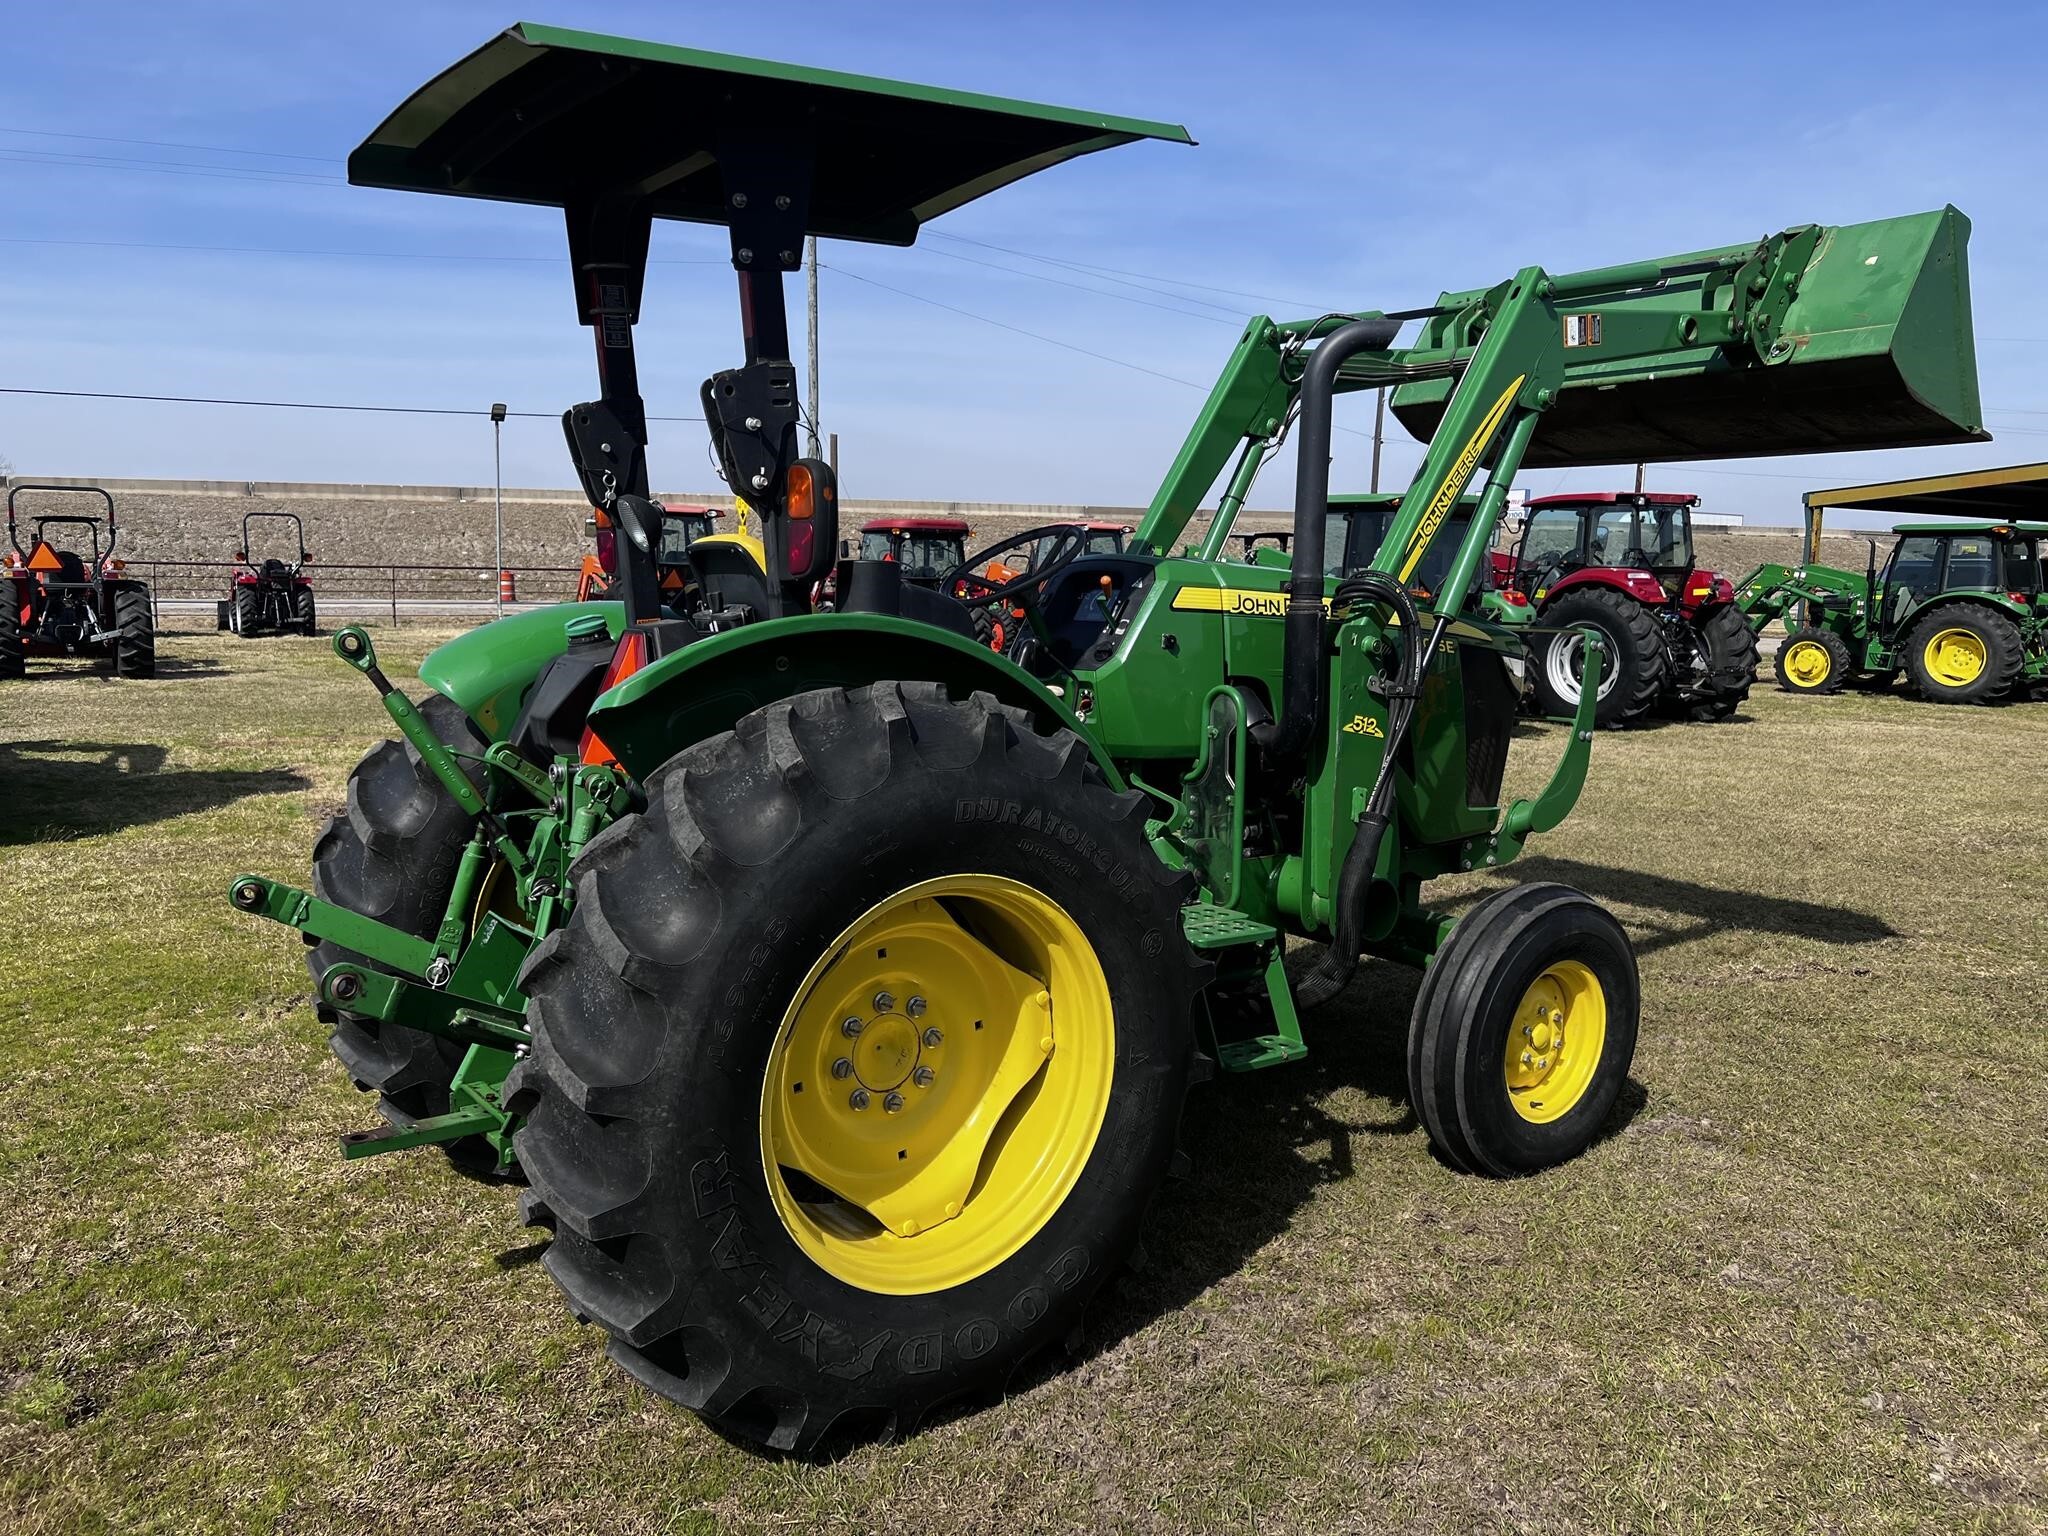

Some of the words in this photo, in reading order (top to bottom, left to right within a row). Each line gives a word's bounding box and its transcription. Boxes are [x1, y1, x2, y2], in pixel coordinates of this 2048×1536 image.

[1418, 490, 1451, 550] JOHN
[1443, 442, 1481, 500] DEERE
[1231, 593, 1282, 615] JOHN
[1352, 715, 1377, 734] 512
